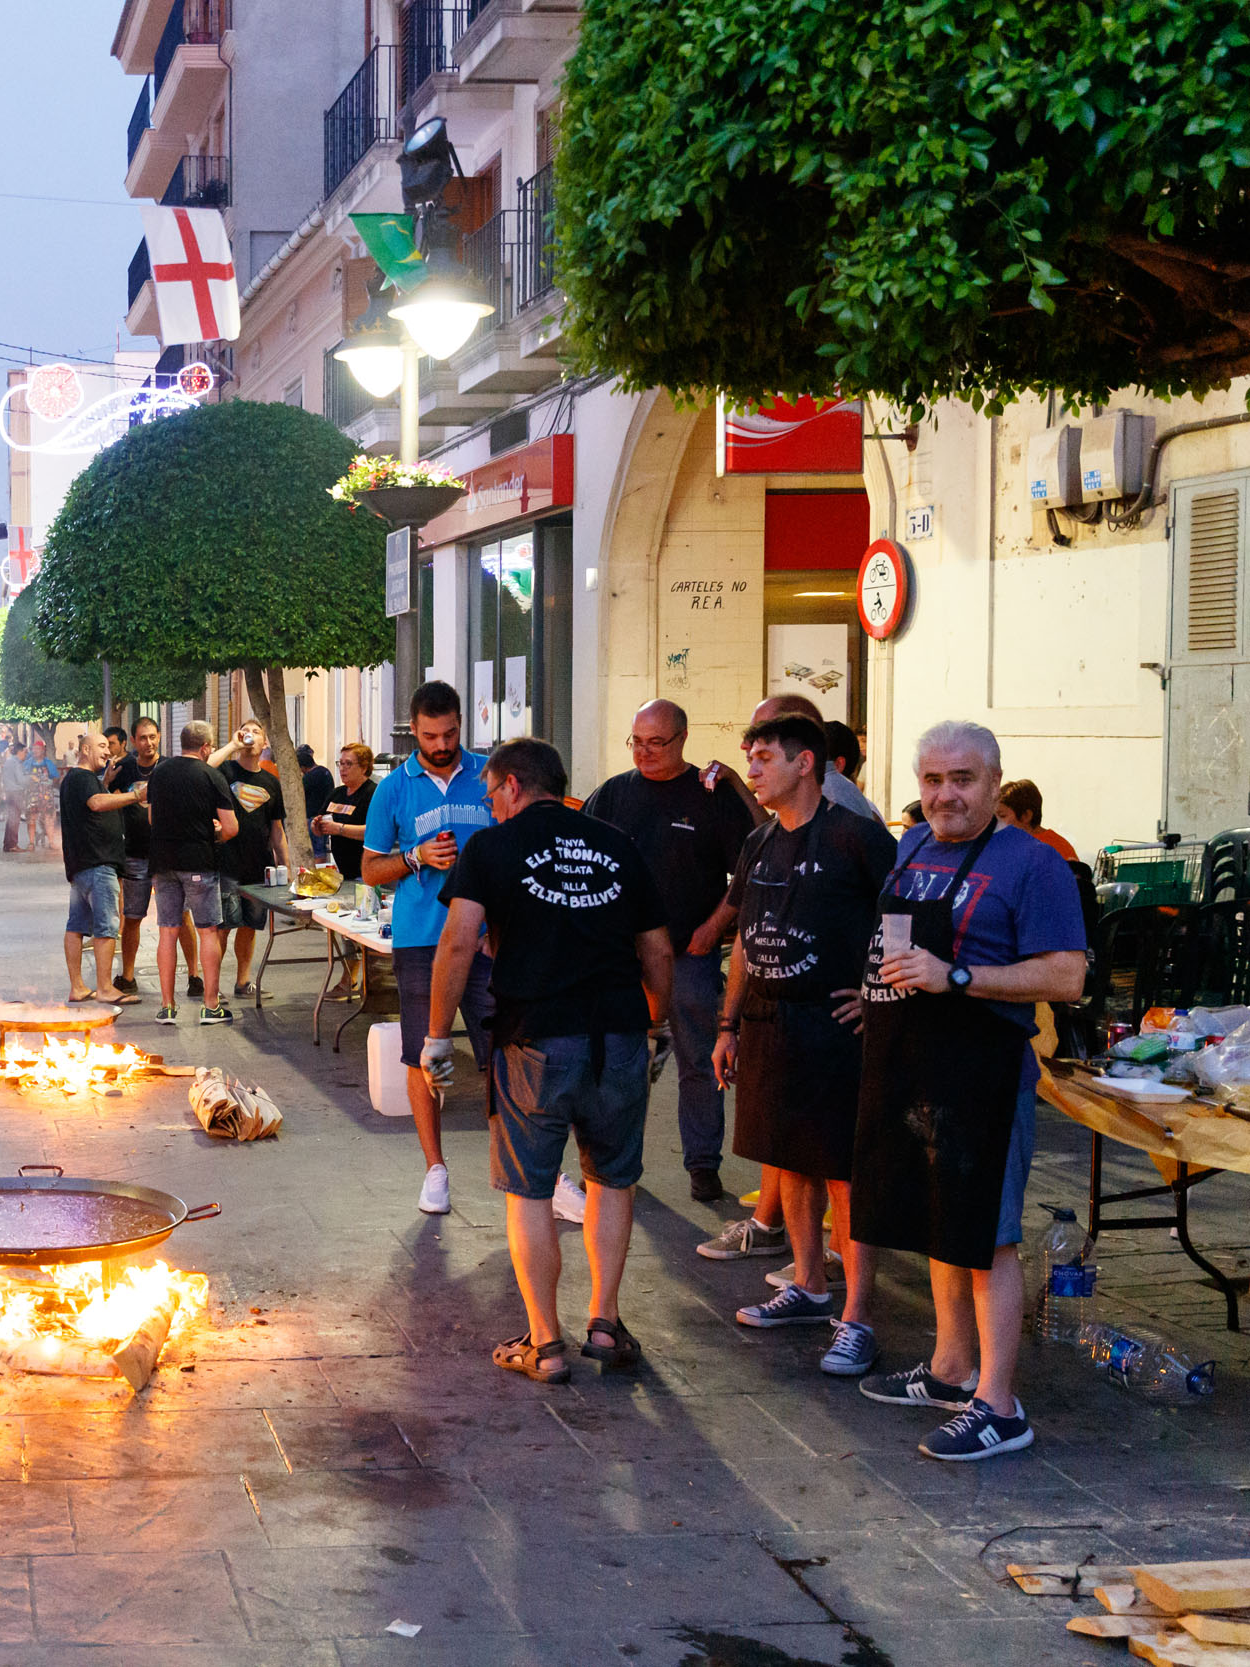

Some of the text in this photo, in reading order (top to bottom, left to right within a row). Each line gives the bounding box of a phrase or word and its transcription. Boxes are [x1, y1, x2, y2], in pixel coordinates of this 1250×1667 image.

[477, 472, 525, 512] Santander
[670, 581, 747, 592] CARTELES NO
[525, 846, 620, 873] ELS TRONATS
[554, 863, 593, 875] MSLATA
[521, 876, 622, 909] FELIPE BELLVER
[562, 882, 588, 892] ALLA
[755, 937, 787, 947] MISLATA
[764, 953, 819, 979] BELLVER
